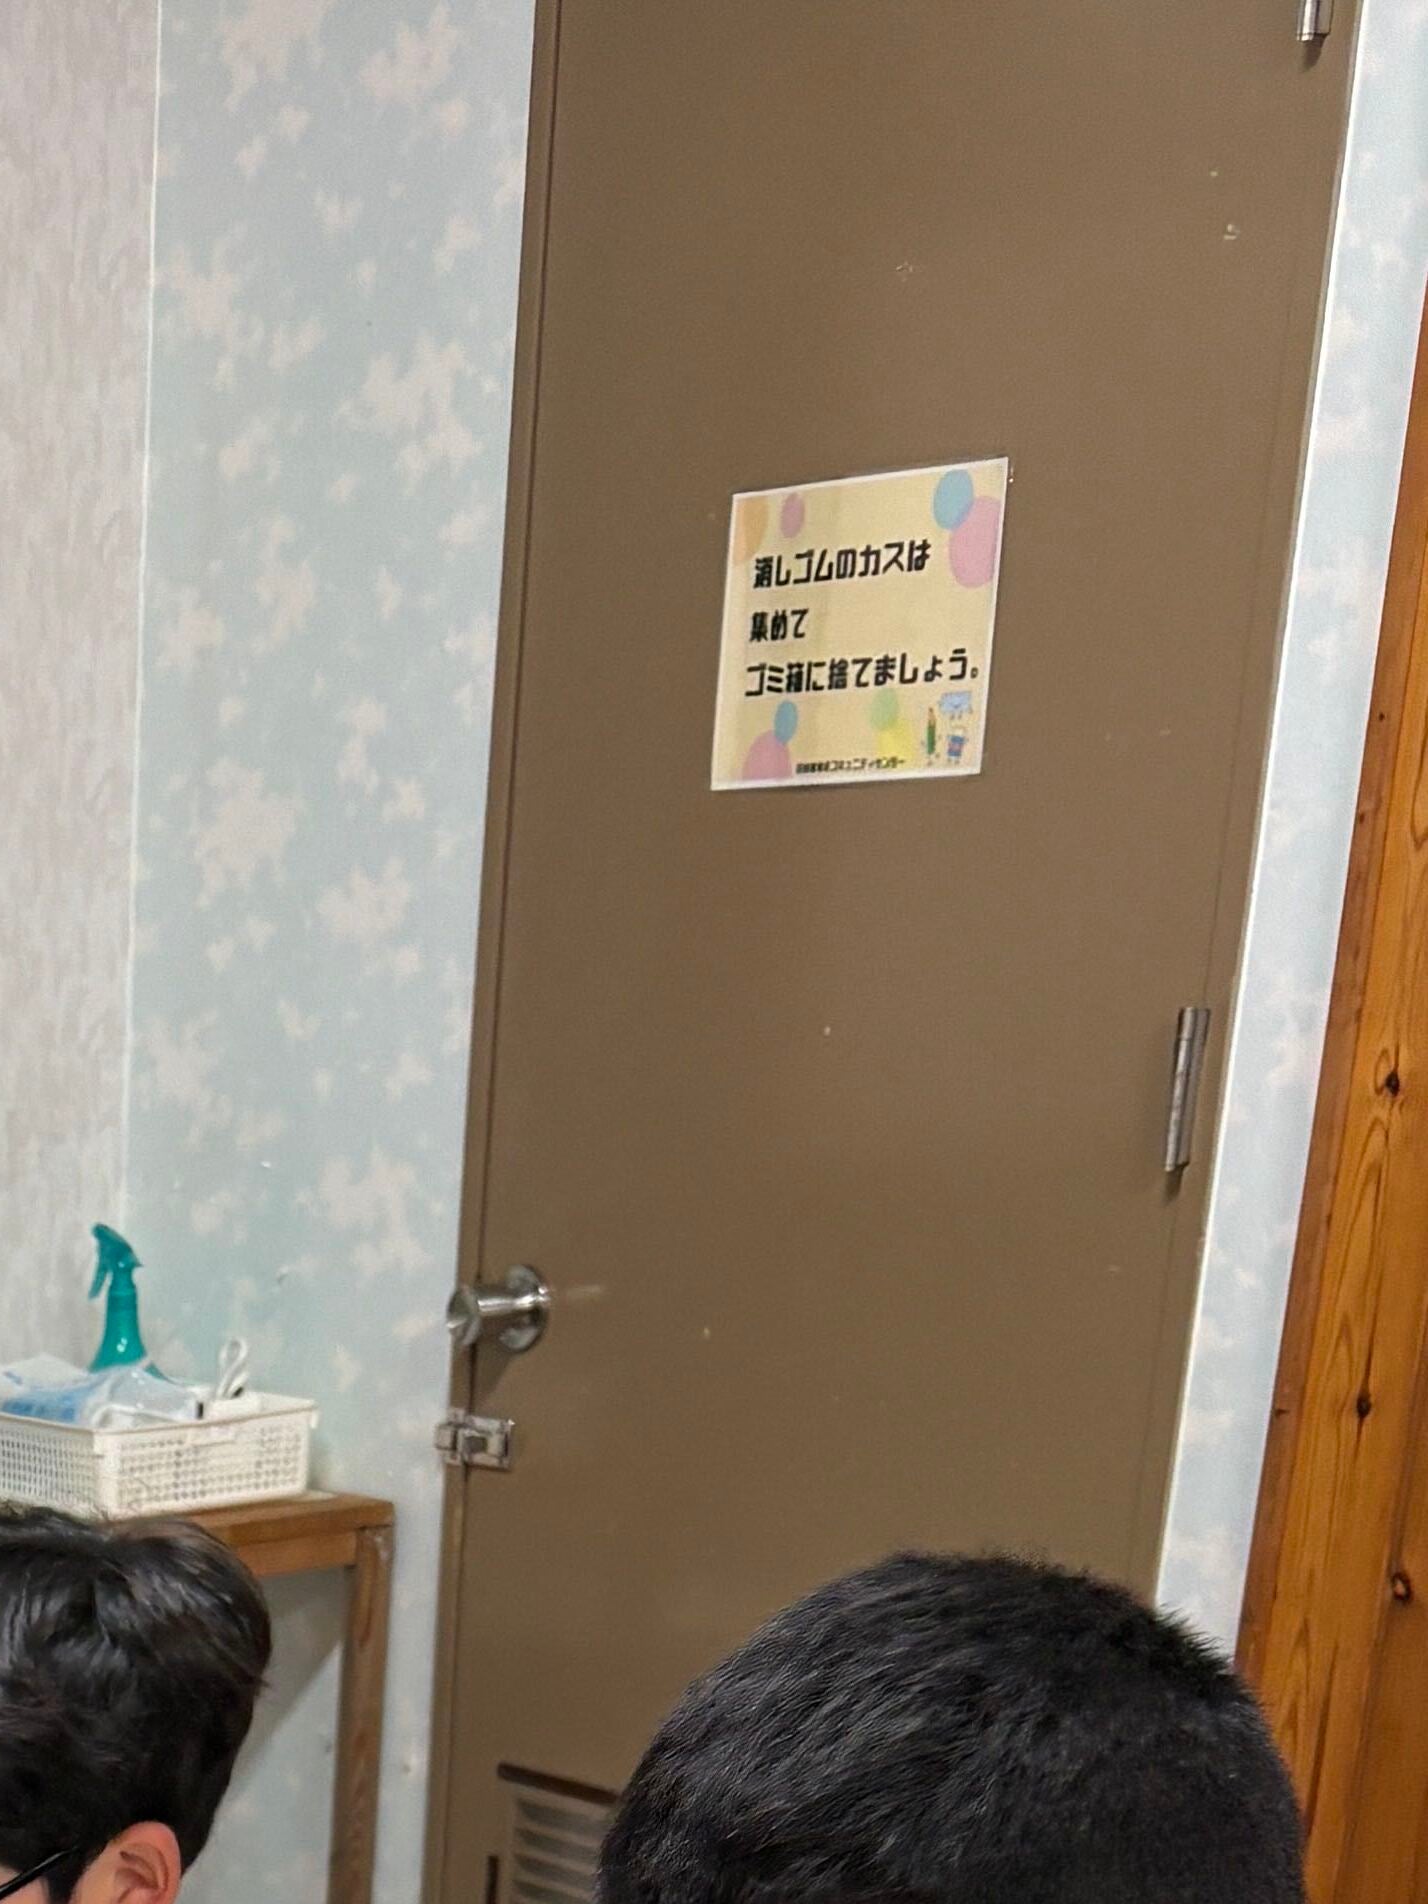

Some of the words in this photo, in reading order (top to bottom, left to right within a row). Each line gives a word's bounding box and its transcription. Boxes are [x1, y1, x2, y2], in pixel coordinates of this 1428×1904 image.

[753, 538, 931, 589] 消しゴムのカスは
[748, 608, 809, 643] 集めて
[745, 648, 978, 697] ゴミ箱に捨てましょう。
